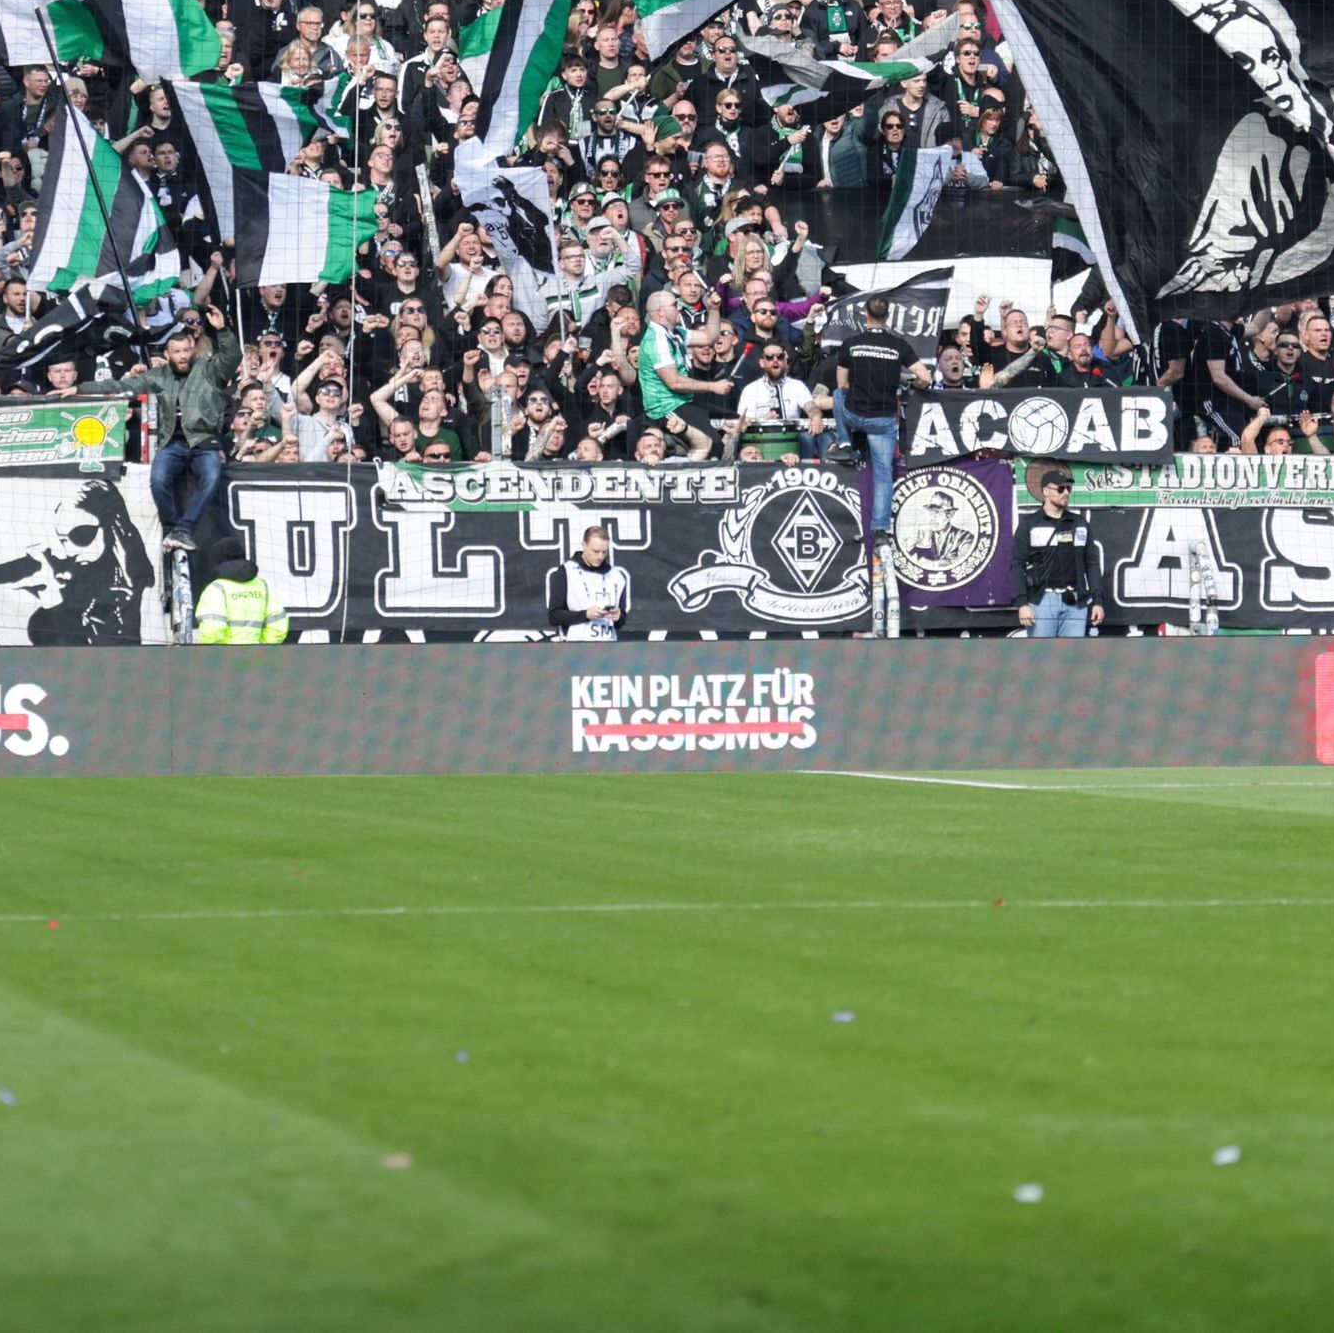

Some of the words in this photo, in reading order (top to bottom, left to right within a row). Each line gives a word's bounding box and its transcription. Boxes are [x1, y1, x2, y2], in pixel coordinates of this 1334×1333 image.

[381, 467, 740, 506] ASCENDENTE
[771, 467, 839, 492] 1900
[571, 675, 644, 708] KEIN
[650, 674, 747, 707] PLATZ
[752, 667, 815, 707] FÜR
[571, 706, 818, 753] RASSISMUS
